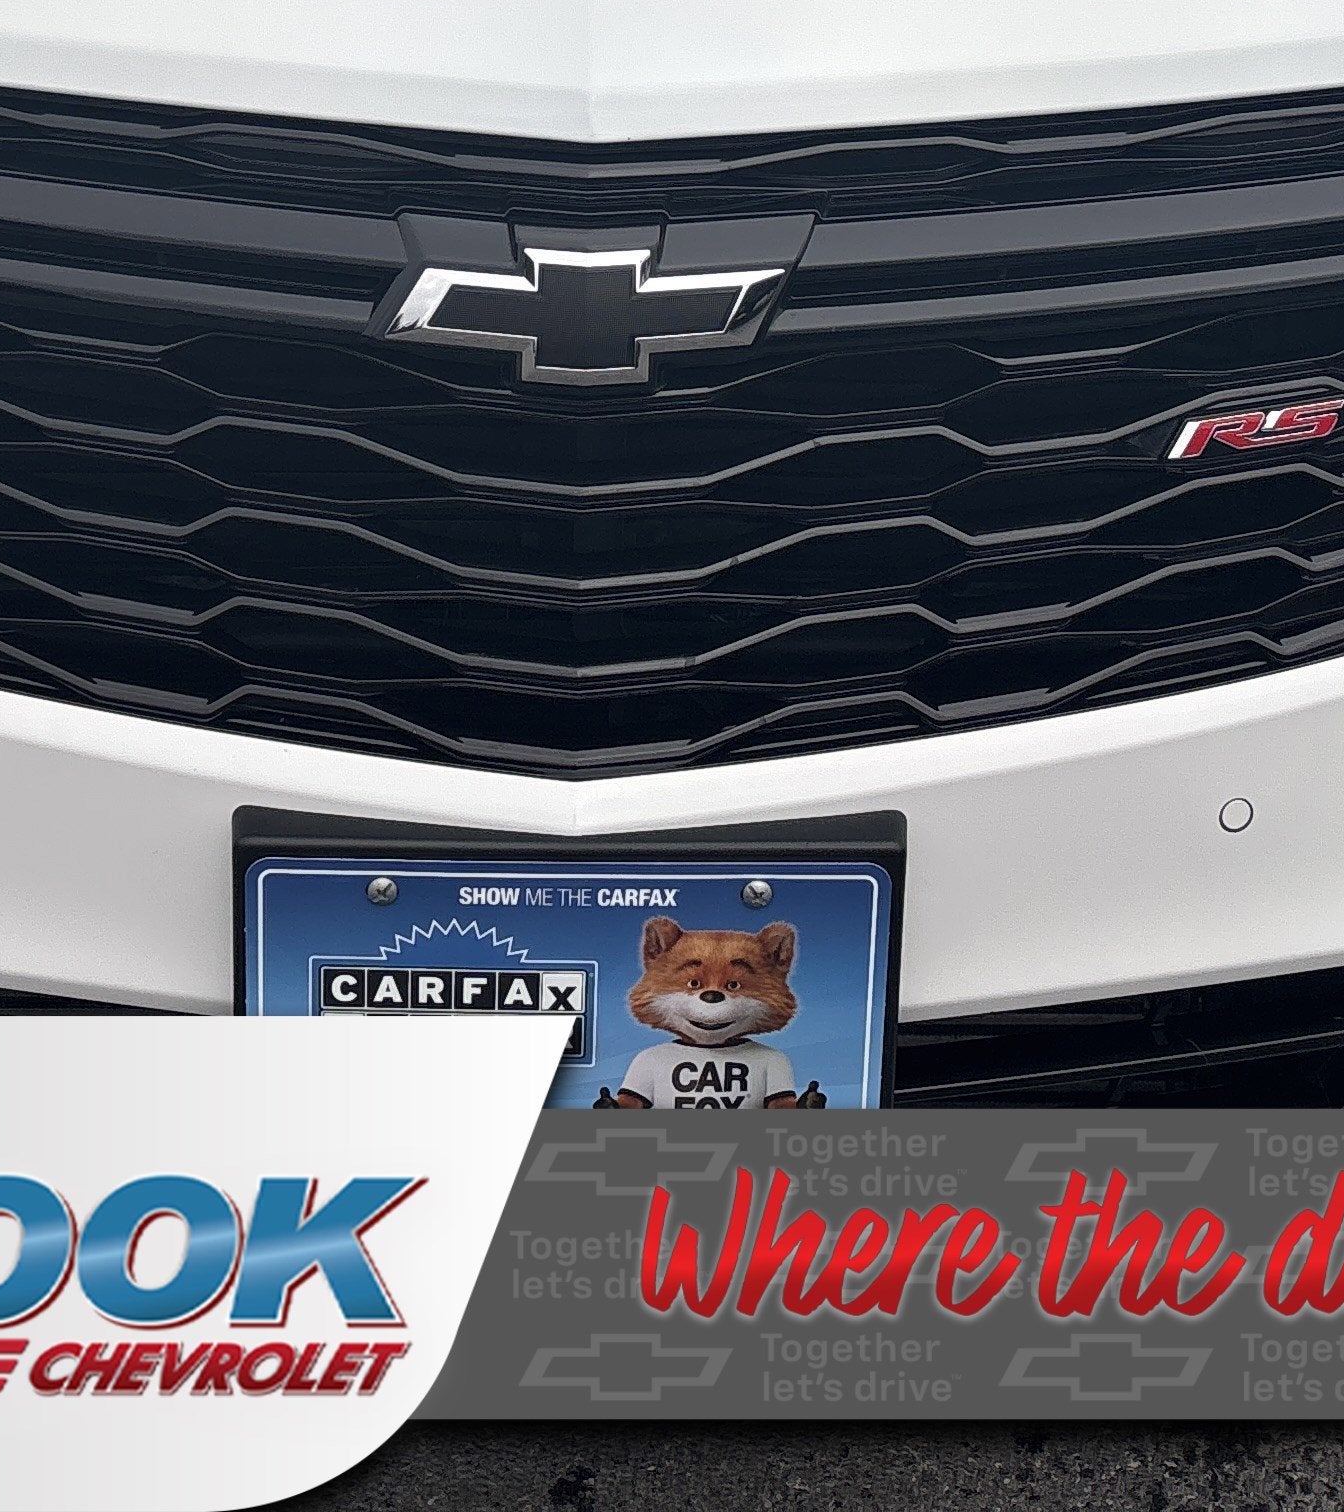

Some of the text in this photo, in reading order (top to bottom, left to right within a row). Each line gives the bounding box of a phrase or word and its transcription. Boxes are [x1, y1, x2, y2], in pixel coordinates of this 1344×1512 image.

[458, 886, 678, 908] SHOW ME THE CARFAX
[330, 974, 578, 1012] CARFAX
[671, 1061, 750, 1094] CAR
